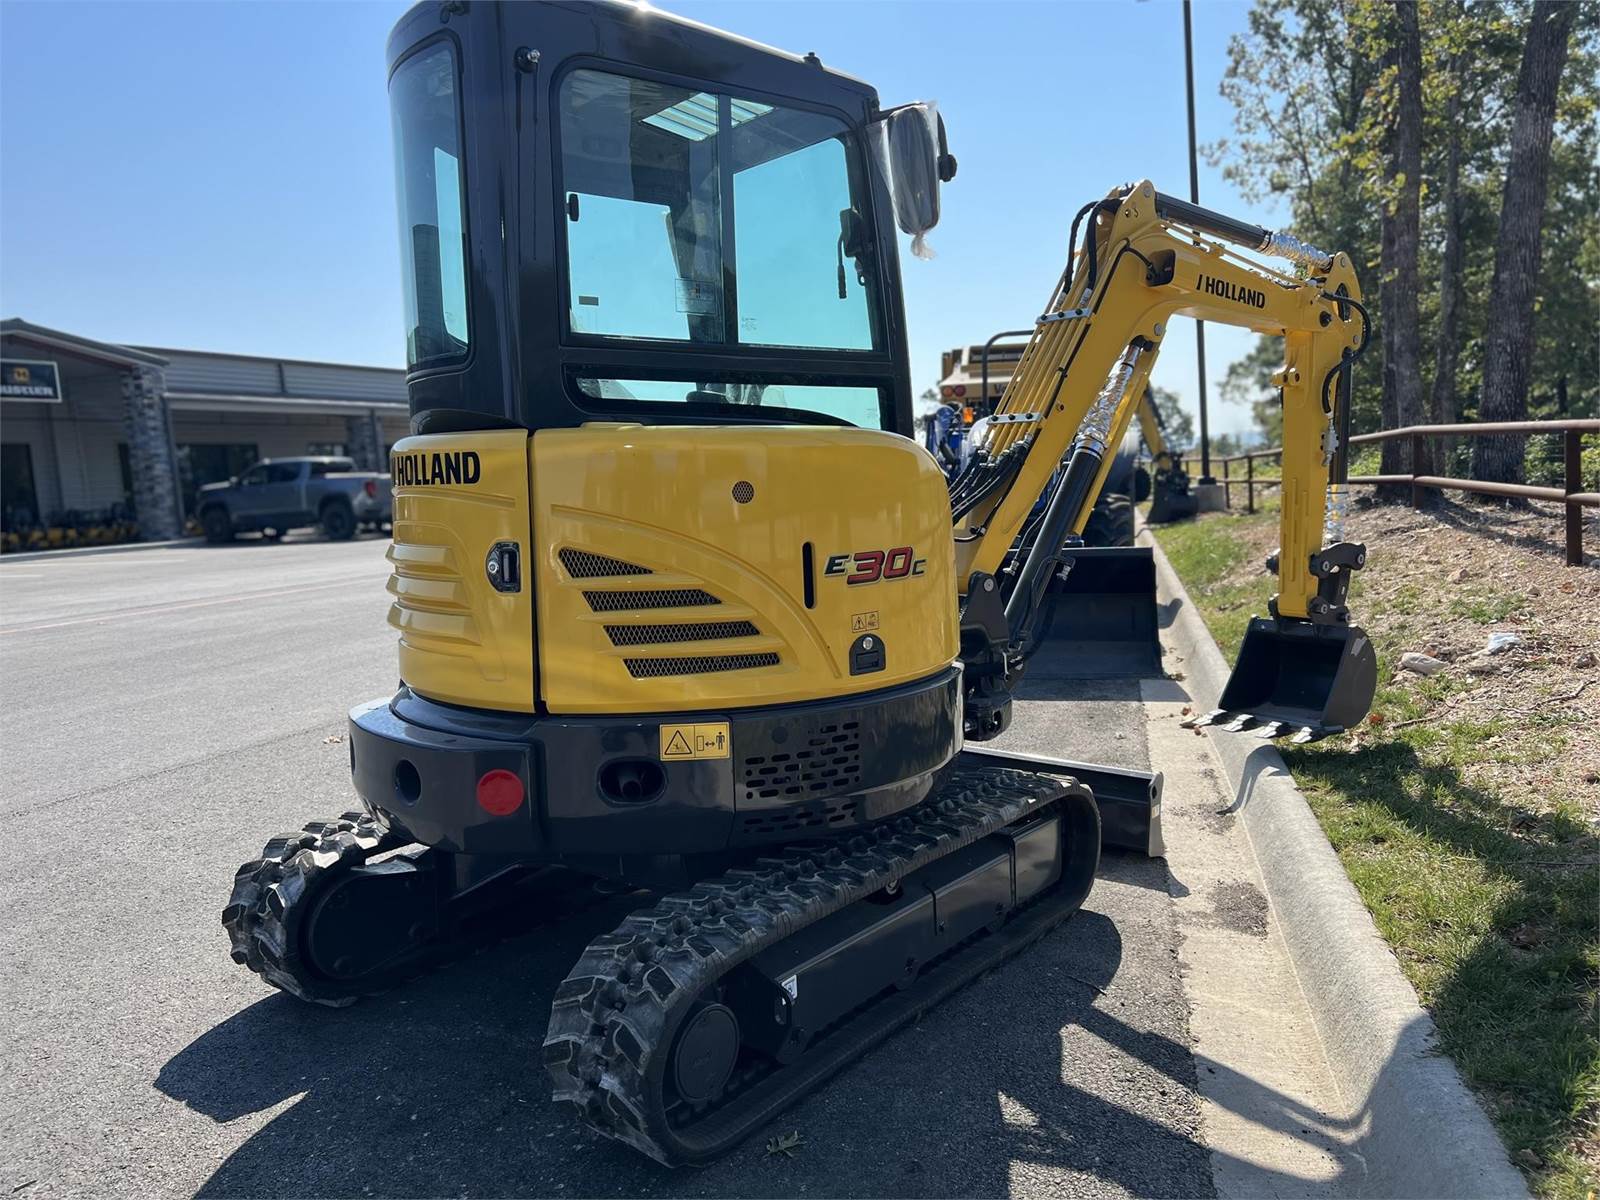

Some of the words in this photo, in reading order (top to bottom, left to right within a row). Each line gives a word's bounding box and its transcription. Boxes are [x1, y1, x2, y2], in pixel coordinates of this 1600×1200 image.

[1205, 275, 1266, 309] HOLLAND
[0, 385, 54, 397] USTLER
[396, 451, 481, 486] HOLLAND
